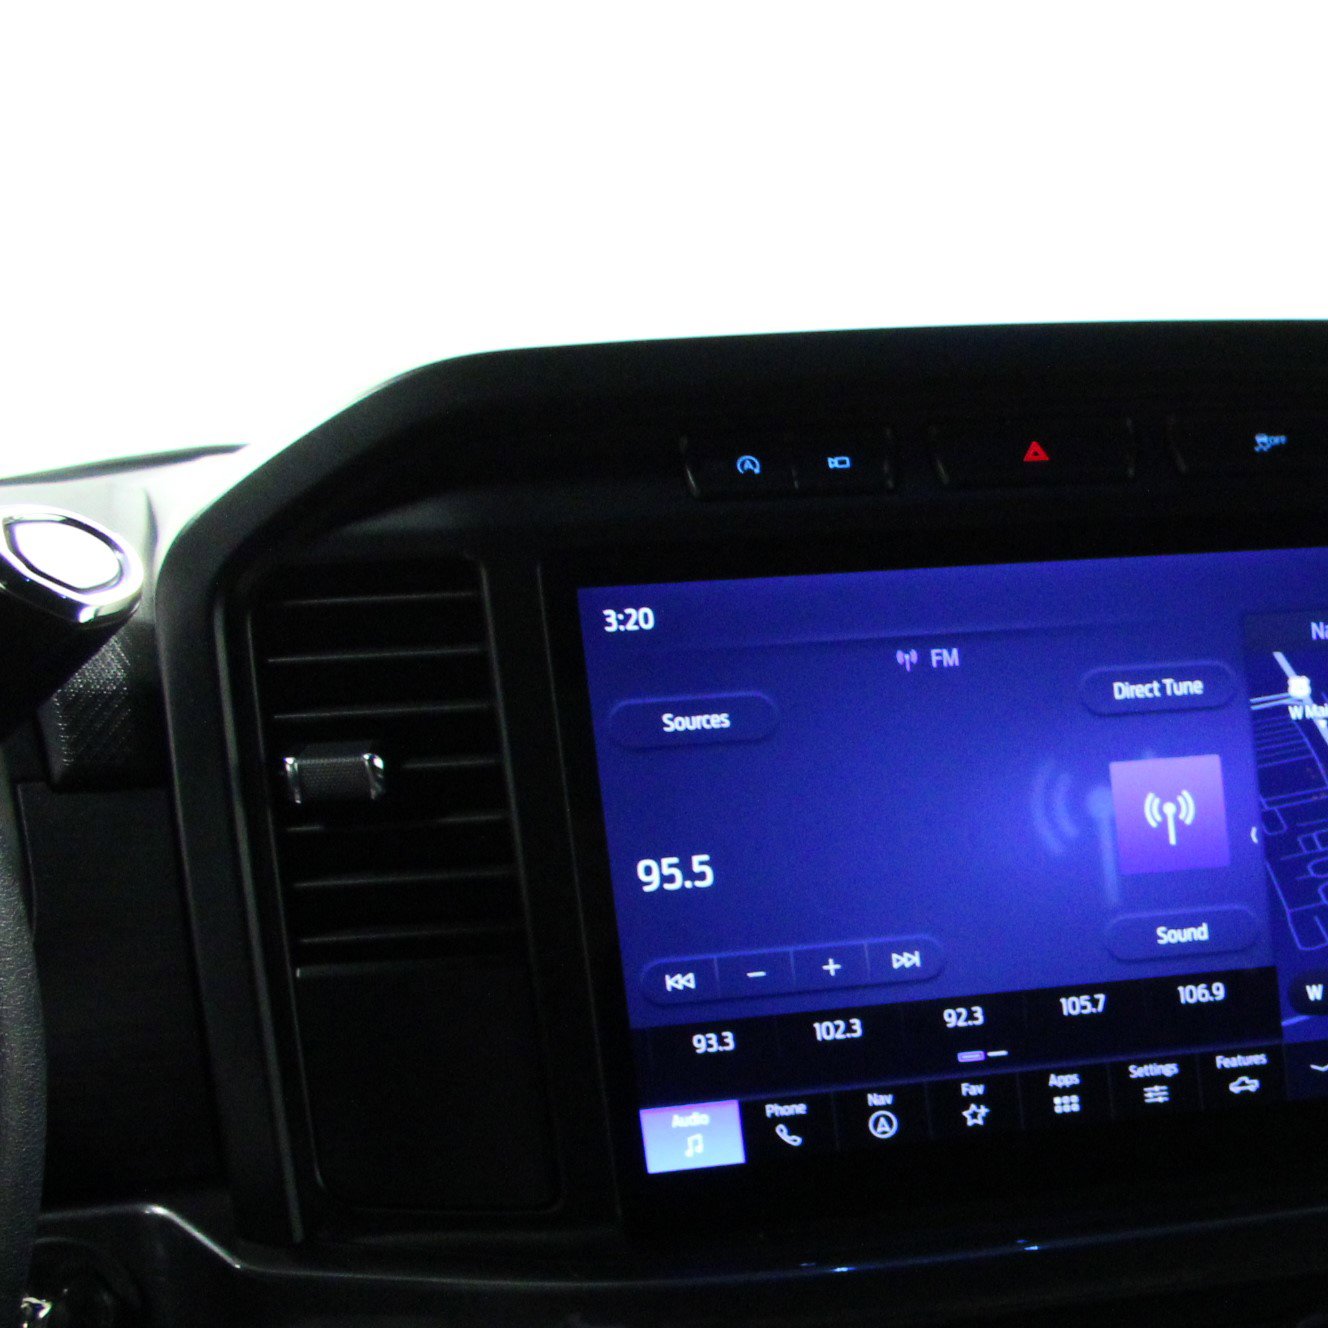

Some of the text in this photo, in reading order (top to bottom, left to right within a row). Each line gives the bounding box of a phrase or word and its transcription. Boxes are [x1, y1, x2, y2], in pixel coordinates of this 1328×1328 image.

[602, 606, 655, 633] 3:20
[930, 647, 960, 668] FM
[1112, 677, 1204, 701] Direct Tune
[661, 712, 731, 733] Sources
[1288, 705, 1303, 720] W
[636, 853, 715, 893] 95.5
[1156, 922, 1210, 945] Sound
[1176, 981, 1226, 1005] 106.9
[1305, 983, 1324, 1002] W
[1059, 992, 1106, 1017] 105.7
[942, 1005, 985, 1028] 92.3
[812, 1017, 863, 1042] 102.3
[691, 1030, 735, 1054] 93.3
[1128, 1062, 1179, 1079] Settings
[1215, 1053, 1268, 1069] Features
[960, 1082, 985, 1097] Fav
[1048, 1073, 1080, 1089] Apps
[764, 1102, 807, 1118] Phone
[866, 1092, 893, 1107] Nav
[671, 1110, 710, 1129] Audio
